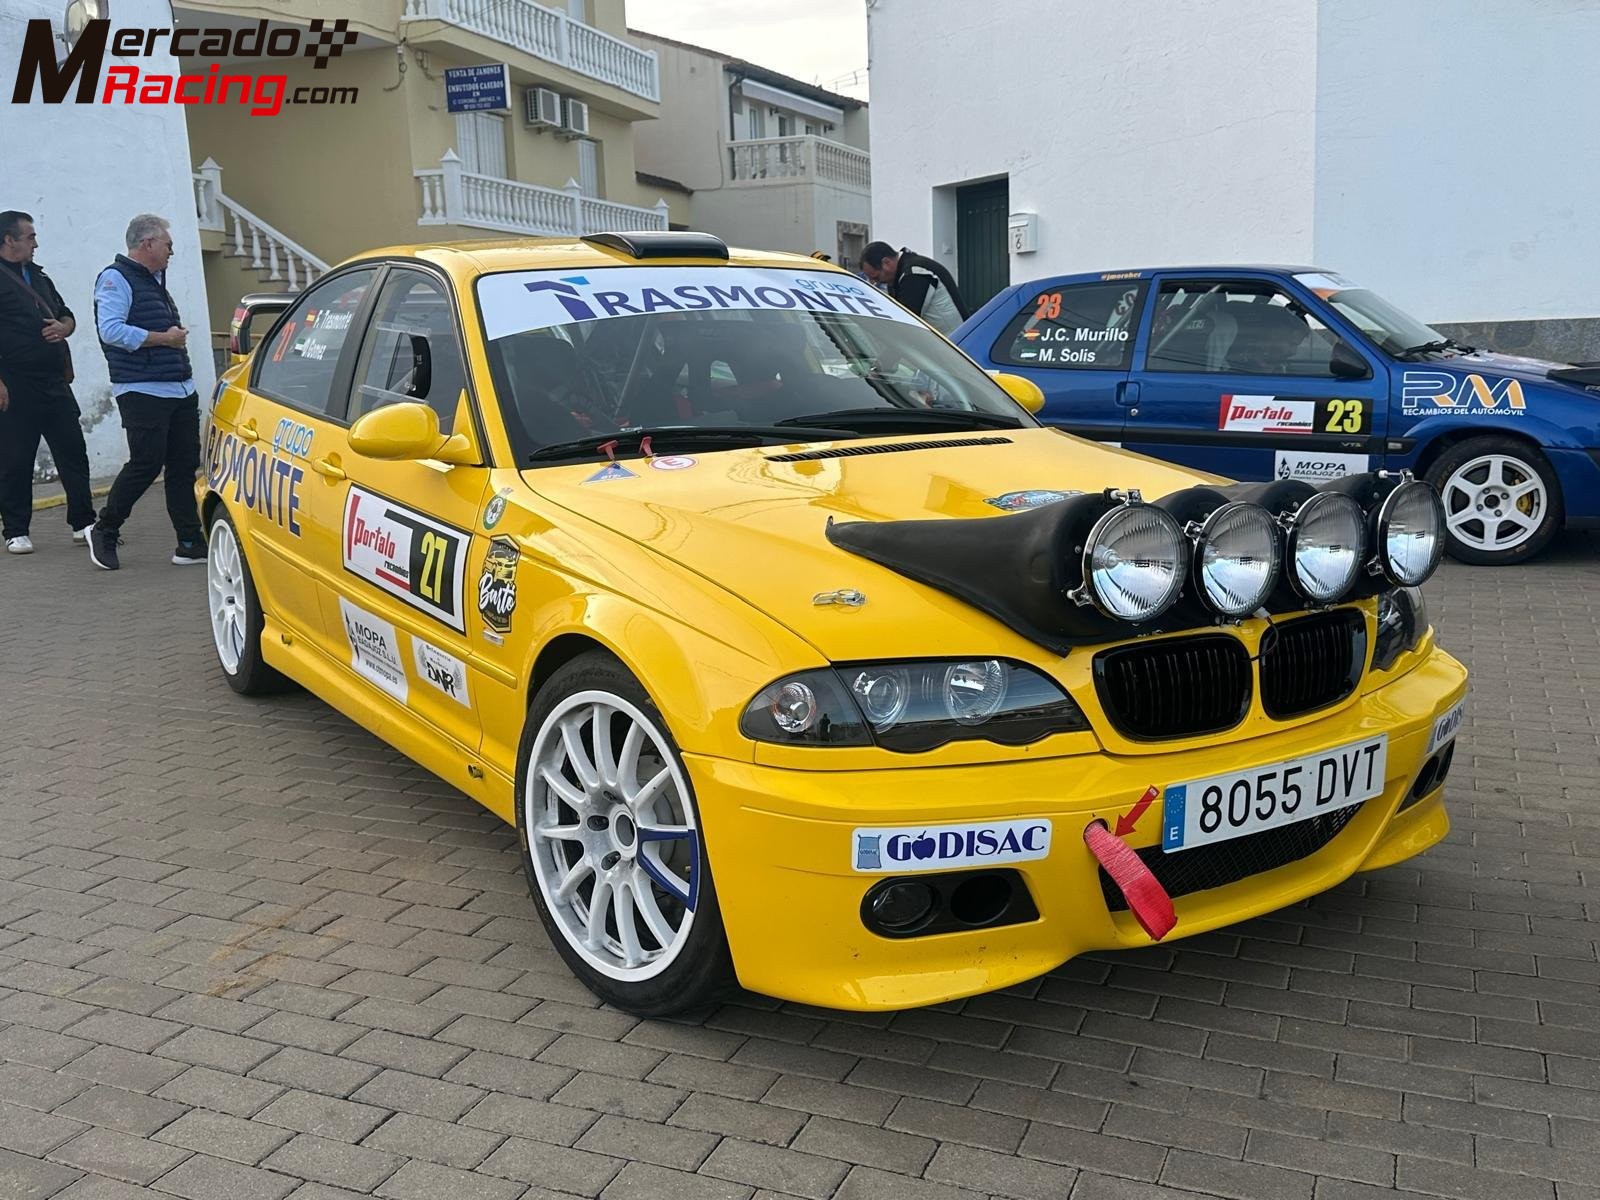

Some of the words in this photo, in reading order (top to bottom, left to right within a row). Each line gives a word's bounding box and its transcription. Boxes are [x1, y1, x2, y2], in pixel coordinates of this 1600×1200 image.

[448, 70, 467, 78] VENTA
[468, 68, 476, 77] DE
[448, 83, 479, 93] EMBUTIDOS
[480, 80, 504, 89] CASEROS
[795, 276, 865, 298] grupo
[1035, 292, 1063, 320] 23
[1041, 328, 1070, 342] J.C.
[1075, 327, 1129, 342] Murillo
[1038, 348, 1056, 362] M.
[1402, 371, 1526, 409] RM
[1230, 405, 1293, 421] Portalo
[1325, 398, 1363, 433] 23
[1403, 408, 1453, 416] RECAMBIOS
[1471, 407, 1524, 416] AUTOMÓVIL
[273, 417, 315, 457] grupo
[1294, 469, 1335, 477] BADAJOZ
[1296, 461, 1346, 471] MOPA
[353, 517, 396, 560] Portalo
[419, 531, 449, 604] 27
[354, 622, 387, 650] MOPA
[1199, 765, 1302, 835] 8055
[1316, 742, 1382, 807] DVT
[1169, 826, 1179, 841] E
